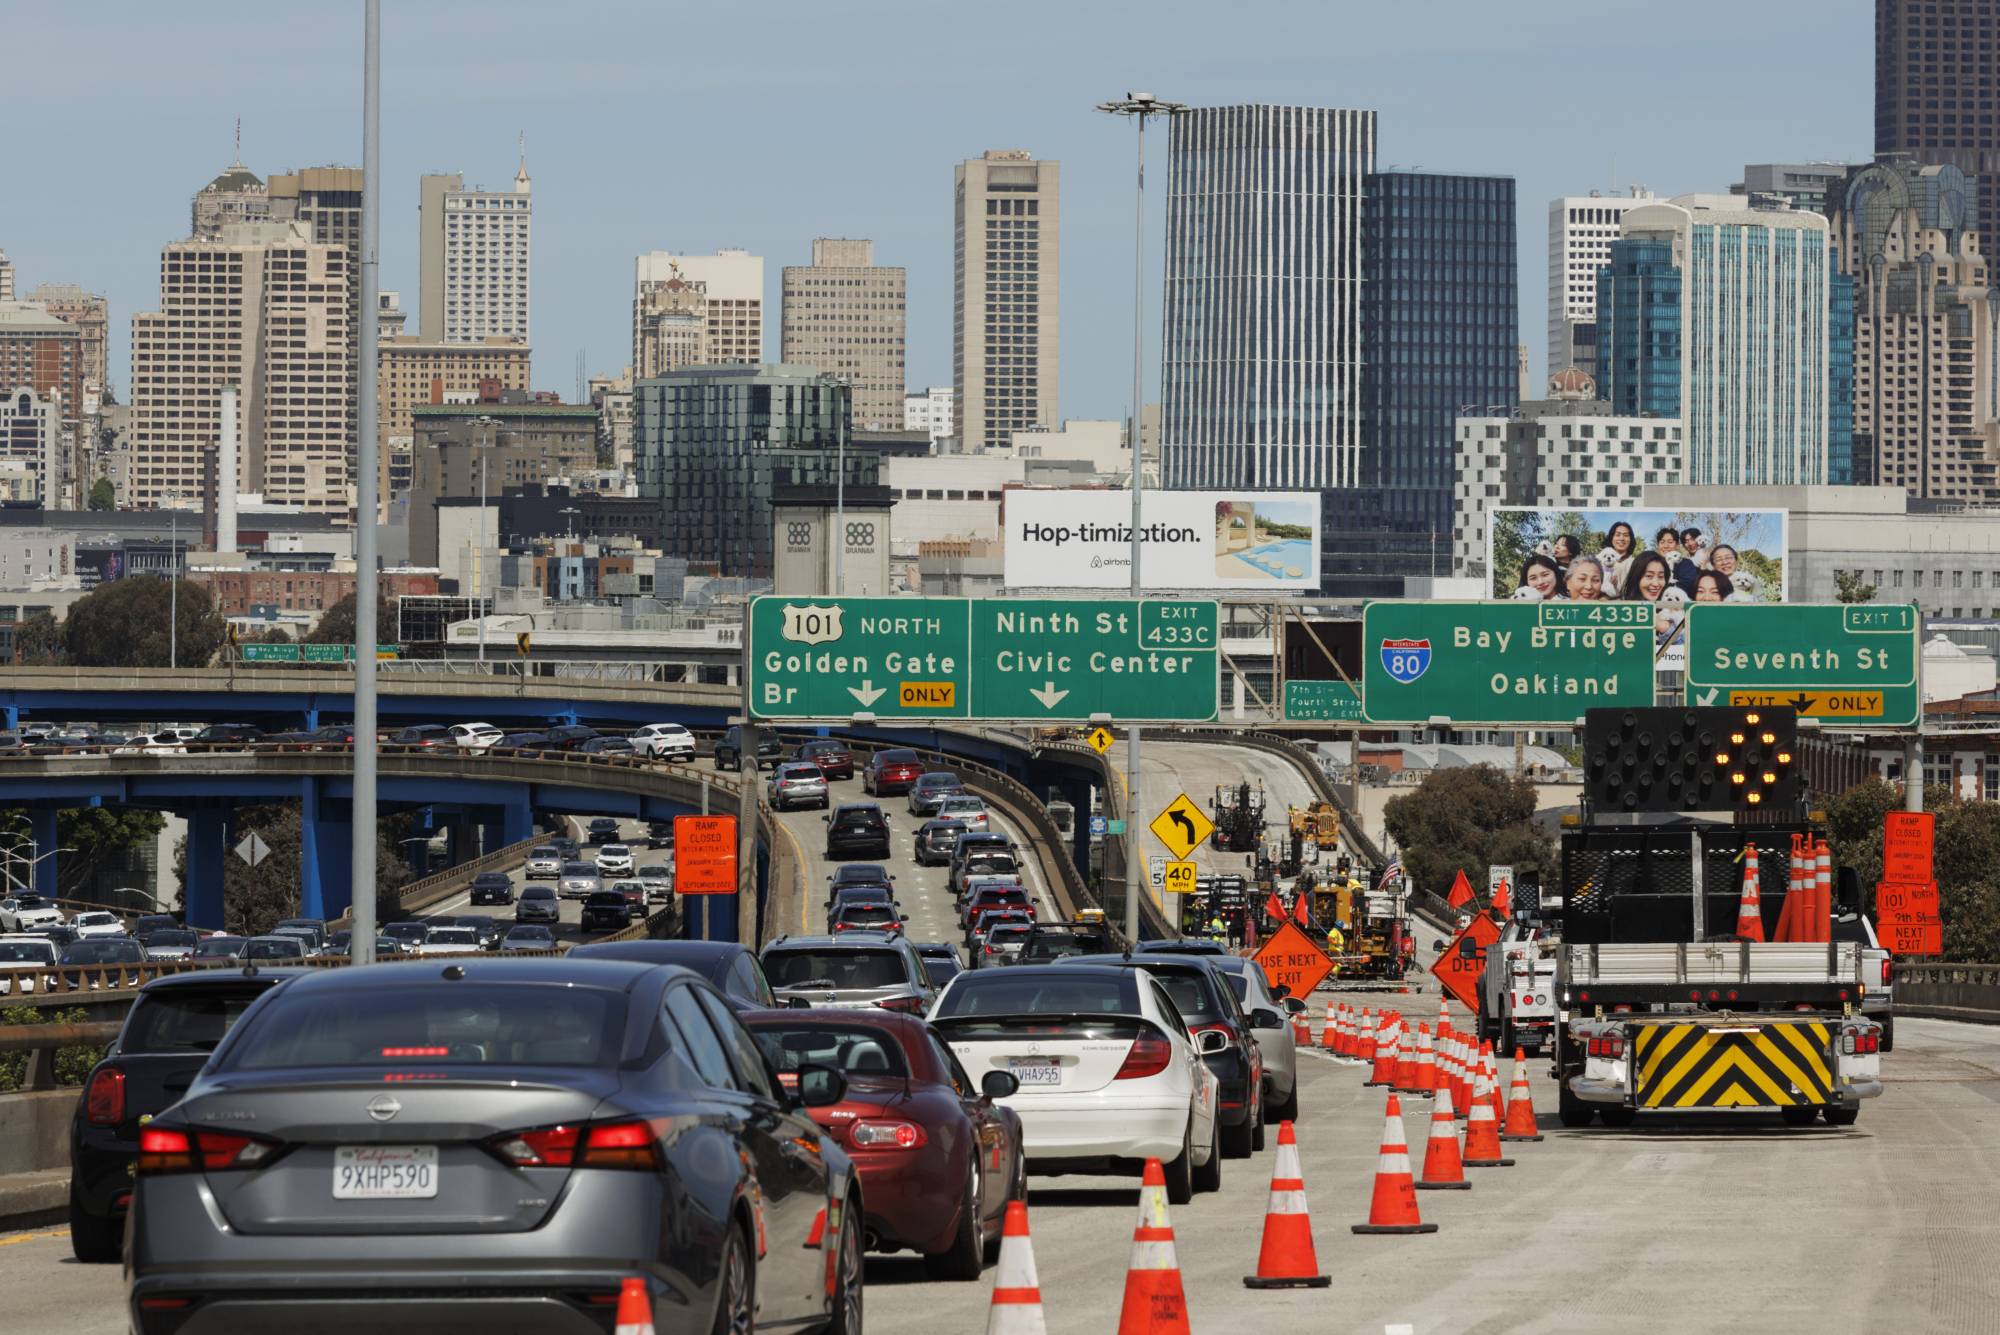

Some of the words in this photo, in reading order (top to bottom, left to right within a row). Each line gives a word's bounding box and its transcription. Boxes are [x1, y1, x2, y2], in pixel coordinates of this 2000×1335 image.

[1023, 523, 1201, 546] Hop-timization.
[1103, 556, 1131, 567] airbnb
[1161, 607, 1198, 618] EXIT
[1545, 608, 1580, 620] EXIT
[1587, 606, 1649, 623] 433B
[1852, 613, 1889, 624] EXIT
[1900, 611, 1907, 626] 1
[794, 614, 833, 636] 101
[861, 618, 940, 635] NORTH
[997, 612, 1080, 634] Ninth
[1095, 613, 1129, 635] St
[1148, 627, 1209, 643] 433C
[1454, 626, 1512, 653] Bay
[1531, 627, 1636, 655] Bridge
[765, 652, 868, 674] Golden
[885, 652, 956, 675] Gate
[997, 651, 1072, 674] Civic
[1090, 652, 1193, 674] Center
[1392, 656, 1420, 675] 80
[1714, 648, 1840, 670] Seventh
[1857, 648, 1888, 670] St
[1291, 686, 1310, 694] 7th
[1490, 674, 1618, 694] Oakland
[764, 683, 797, 705] Br
[902, 688, 952, 703] ONLY
[1290, 698, 1326, 706] Fourth
[1733, 696, 1775, 706] EXIT
[1829, 697, 1878, 710] ONLY
[695, 821, 719, 830] RAMP
[1900, 817, 1920, 825] RAMP
[690, 833, 722, 843] CLOSED
[1896, 829, 1921, 837] CLOSED
[1169, 868, 1192, 880] 40
[1885, 894, 1903, 907] 101
[1912, 890, 1934, 900] NORTH
[1895, 912, 1912, 923] 9th
[1916, 911, 1927, 922] St
[1896, 928, 1923, 938] NEXT
[1898, 940, 1921, 950] EXIT
[1260, 956, 1284, 968] USE
[1288, 954, 1317, 966] NEXT
[1277, 971, 1302, 984] EXIT
[341, 1164, 430, 1189] 9XHP590
